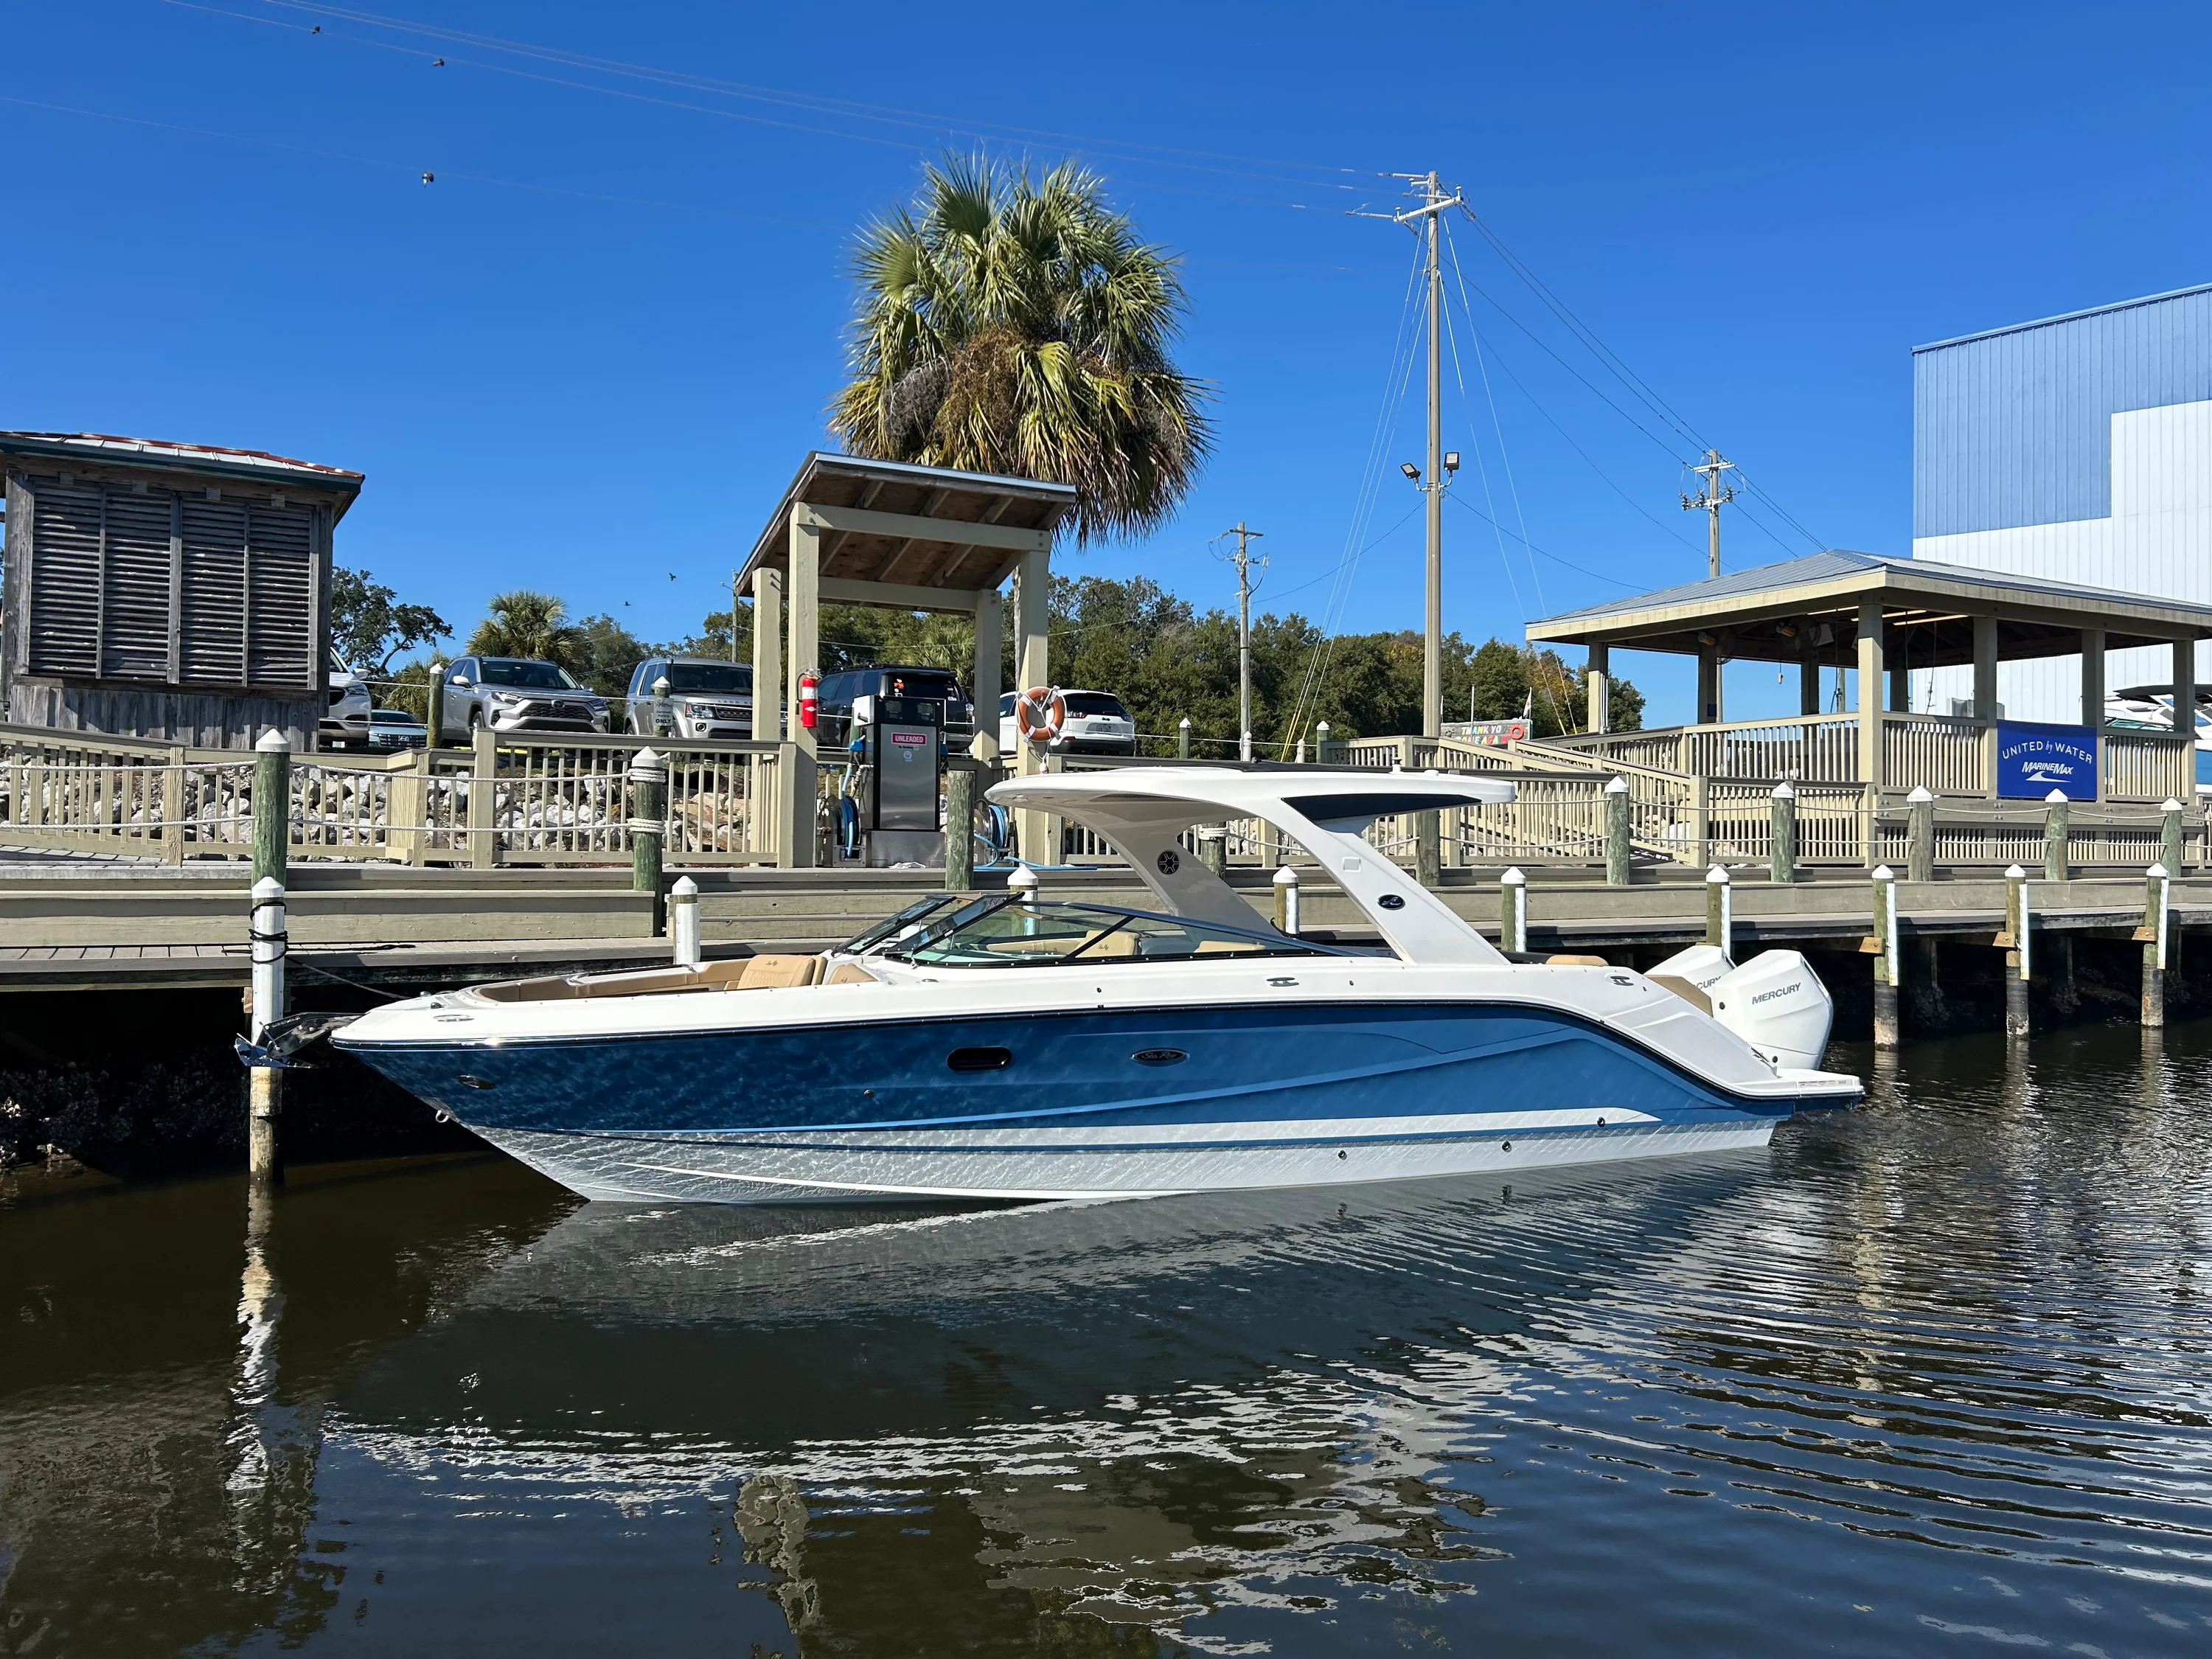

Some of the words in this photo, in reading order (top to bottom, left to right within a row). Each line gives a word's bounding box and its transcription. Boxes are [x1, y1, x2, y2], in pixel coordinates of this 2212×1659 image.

[1461, 725, 1489, 735] THANK
[894, 734, 924, 743] UNLEADED
[1481, 734, 1508, 745] AGAIN
[2002, 741, 2043, 759] UNITED
[2045, 740, 2053, 754] by
[2055, 742, 2093, 764] WATER
[1696, 975, 1722, 990] CURY
[1751, 982, 1801, 1005] MERCURY
[1141, 1051, 1158, 1060] Sea
[1159, 1051, 1178, 1060] Ray
